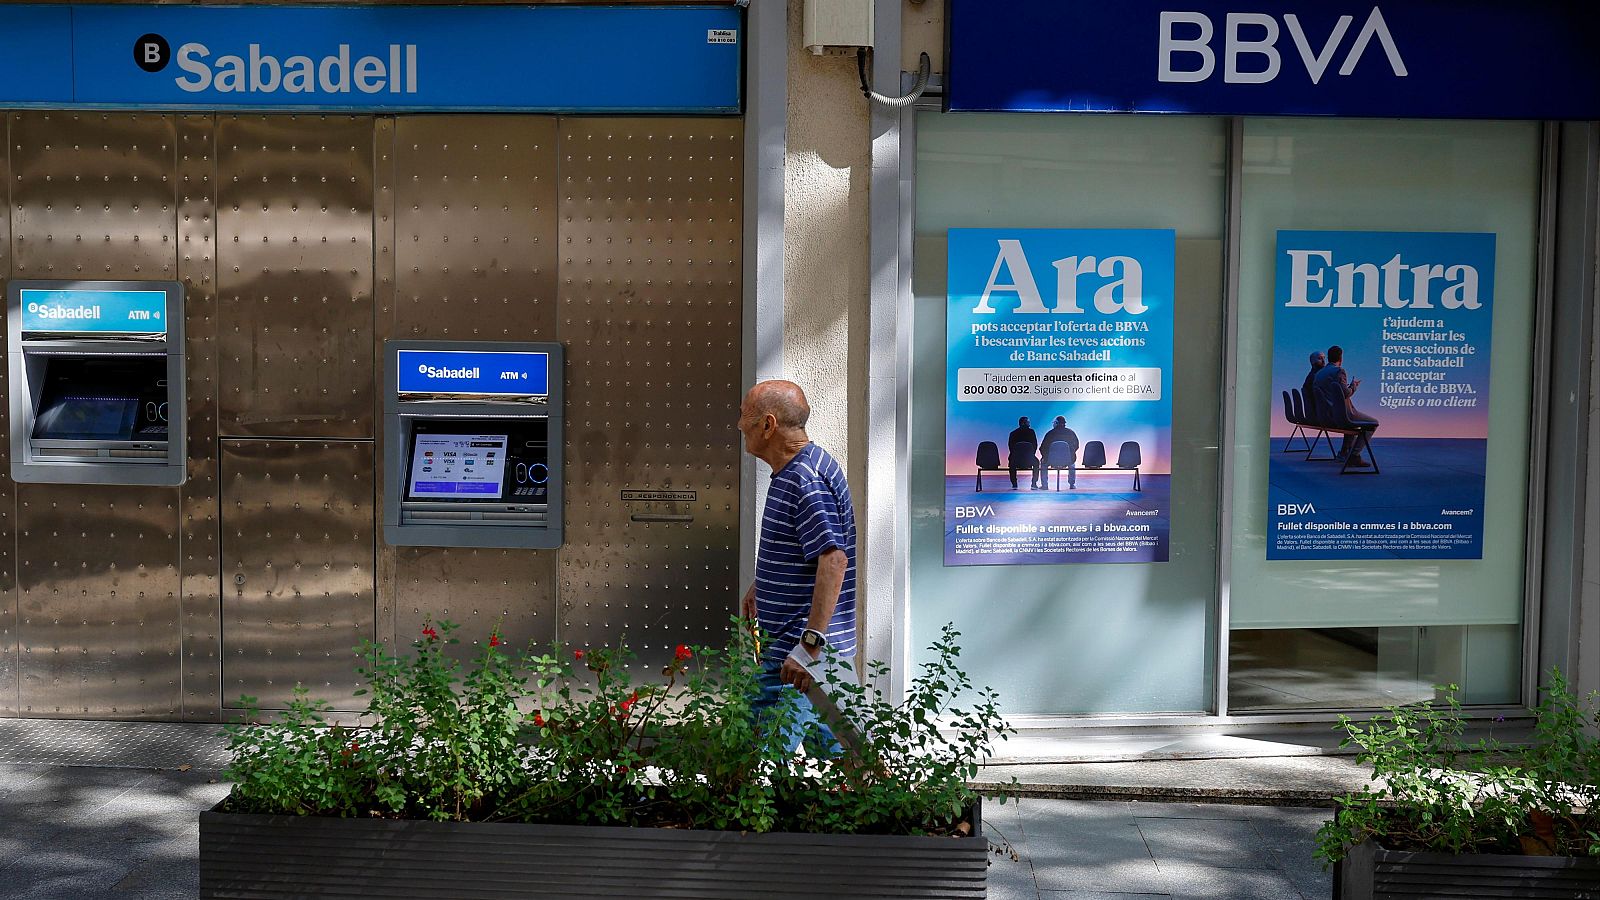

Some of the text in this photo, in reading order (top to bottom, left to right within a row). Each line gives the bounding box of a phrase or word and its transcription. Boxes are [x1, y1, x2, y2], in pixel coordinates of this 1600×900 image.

[1158, 6, 1408, 84] BBVA
[175, 42, 417, 94] Sabadell
[972, 240, 1148, 314] Ara
[1284, 250, 1482, 310] Entra
[38, 305, 100, 319] Sabadell
[128, 311, 149, 320] ATM
[971, 322, 998, 334] pots
[1000, 322, 1052, 334] acceptar
[1099, 321, 1114, 332] de
[1115, 321, 1149, 332] BBVA
[1437, 319, 1444, 328] a
[975, 336, 1145, 347] i bescanviar les teves accions
[1382, 330, 1465, 341] bescanviar les
[1382, 344, 1475, 354] teves accions de
[1010, 350, 1110, 361] de Banc Sabadell
[1382, 357, 1464, 367] Banc Sabadell
[428, 367, 479, 379] Sabadell
[1043, 374, 1082, 384] aquesta
[1085, 373, 1118, 382] oficina
[1128, 373, 1136, 381] al
[1381, 369, 1446, 382] i a acceptar
[964, 385, 984, 394] 800
[987, 385, 1008, 394] 080
[1010, 385, 1032, 394] 032.
[1034, 385, 1062, 396] Siguis
[1086, 384, 1110, 394] client
[1113, 385, 1124, 394] de
[1127, 385, 1155, 394] BBVA.
[1424, 383, 1438, 393] de
[1440, 384, 1476, 393] BBVA.
[1380, 396, 1477, 409] Siguis o no client
[956, 505, 995, 518] BBVA
[1278, 502, 1316, 516] BBVA
[956, 525, 983, 533] Fullet
[986, 524, 1037, 535] disponible
[1090, 523, 1092, 532] i
[1104, 523, 1150, 532] bbva.com
[1304, 522, 1350, 531] disponible
